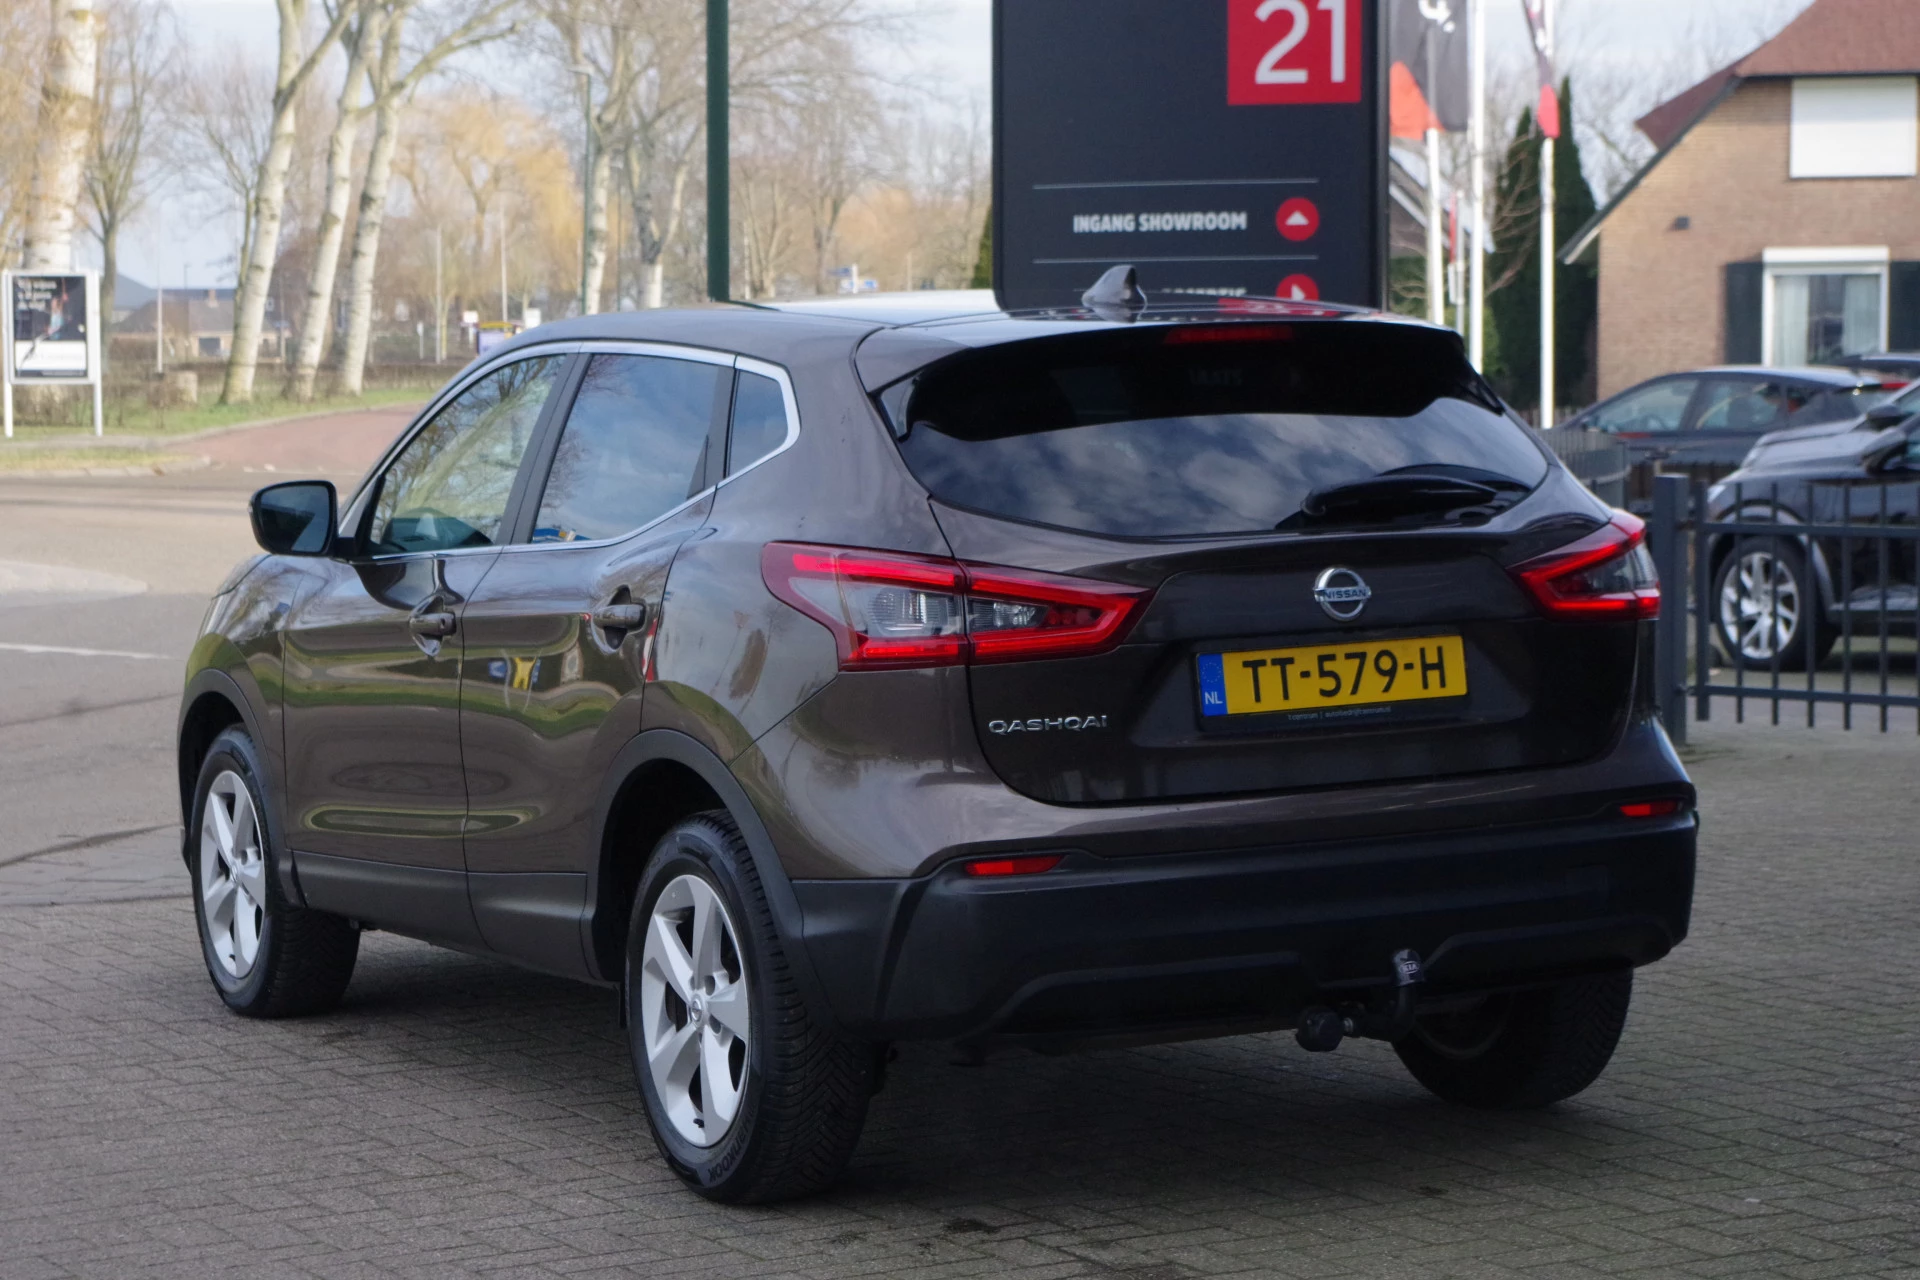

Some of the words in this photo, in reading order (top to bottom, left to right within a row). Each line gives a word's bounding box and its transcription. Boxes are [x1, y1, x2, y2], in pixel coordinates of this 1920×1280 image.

[1254, 0, 1346, 84] 21
[1073, 214, 1136, 233] INGANG
[1138, 211, 1248, 232] SHOWROOM
[1323, 589, 1367, 599] NISSAN
[1242, 645, 1447, 703] TT-579-H
[1204, 691, 1223, 705] NL
